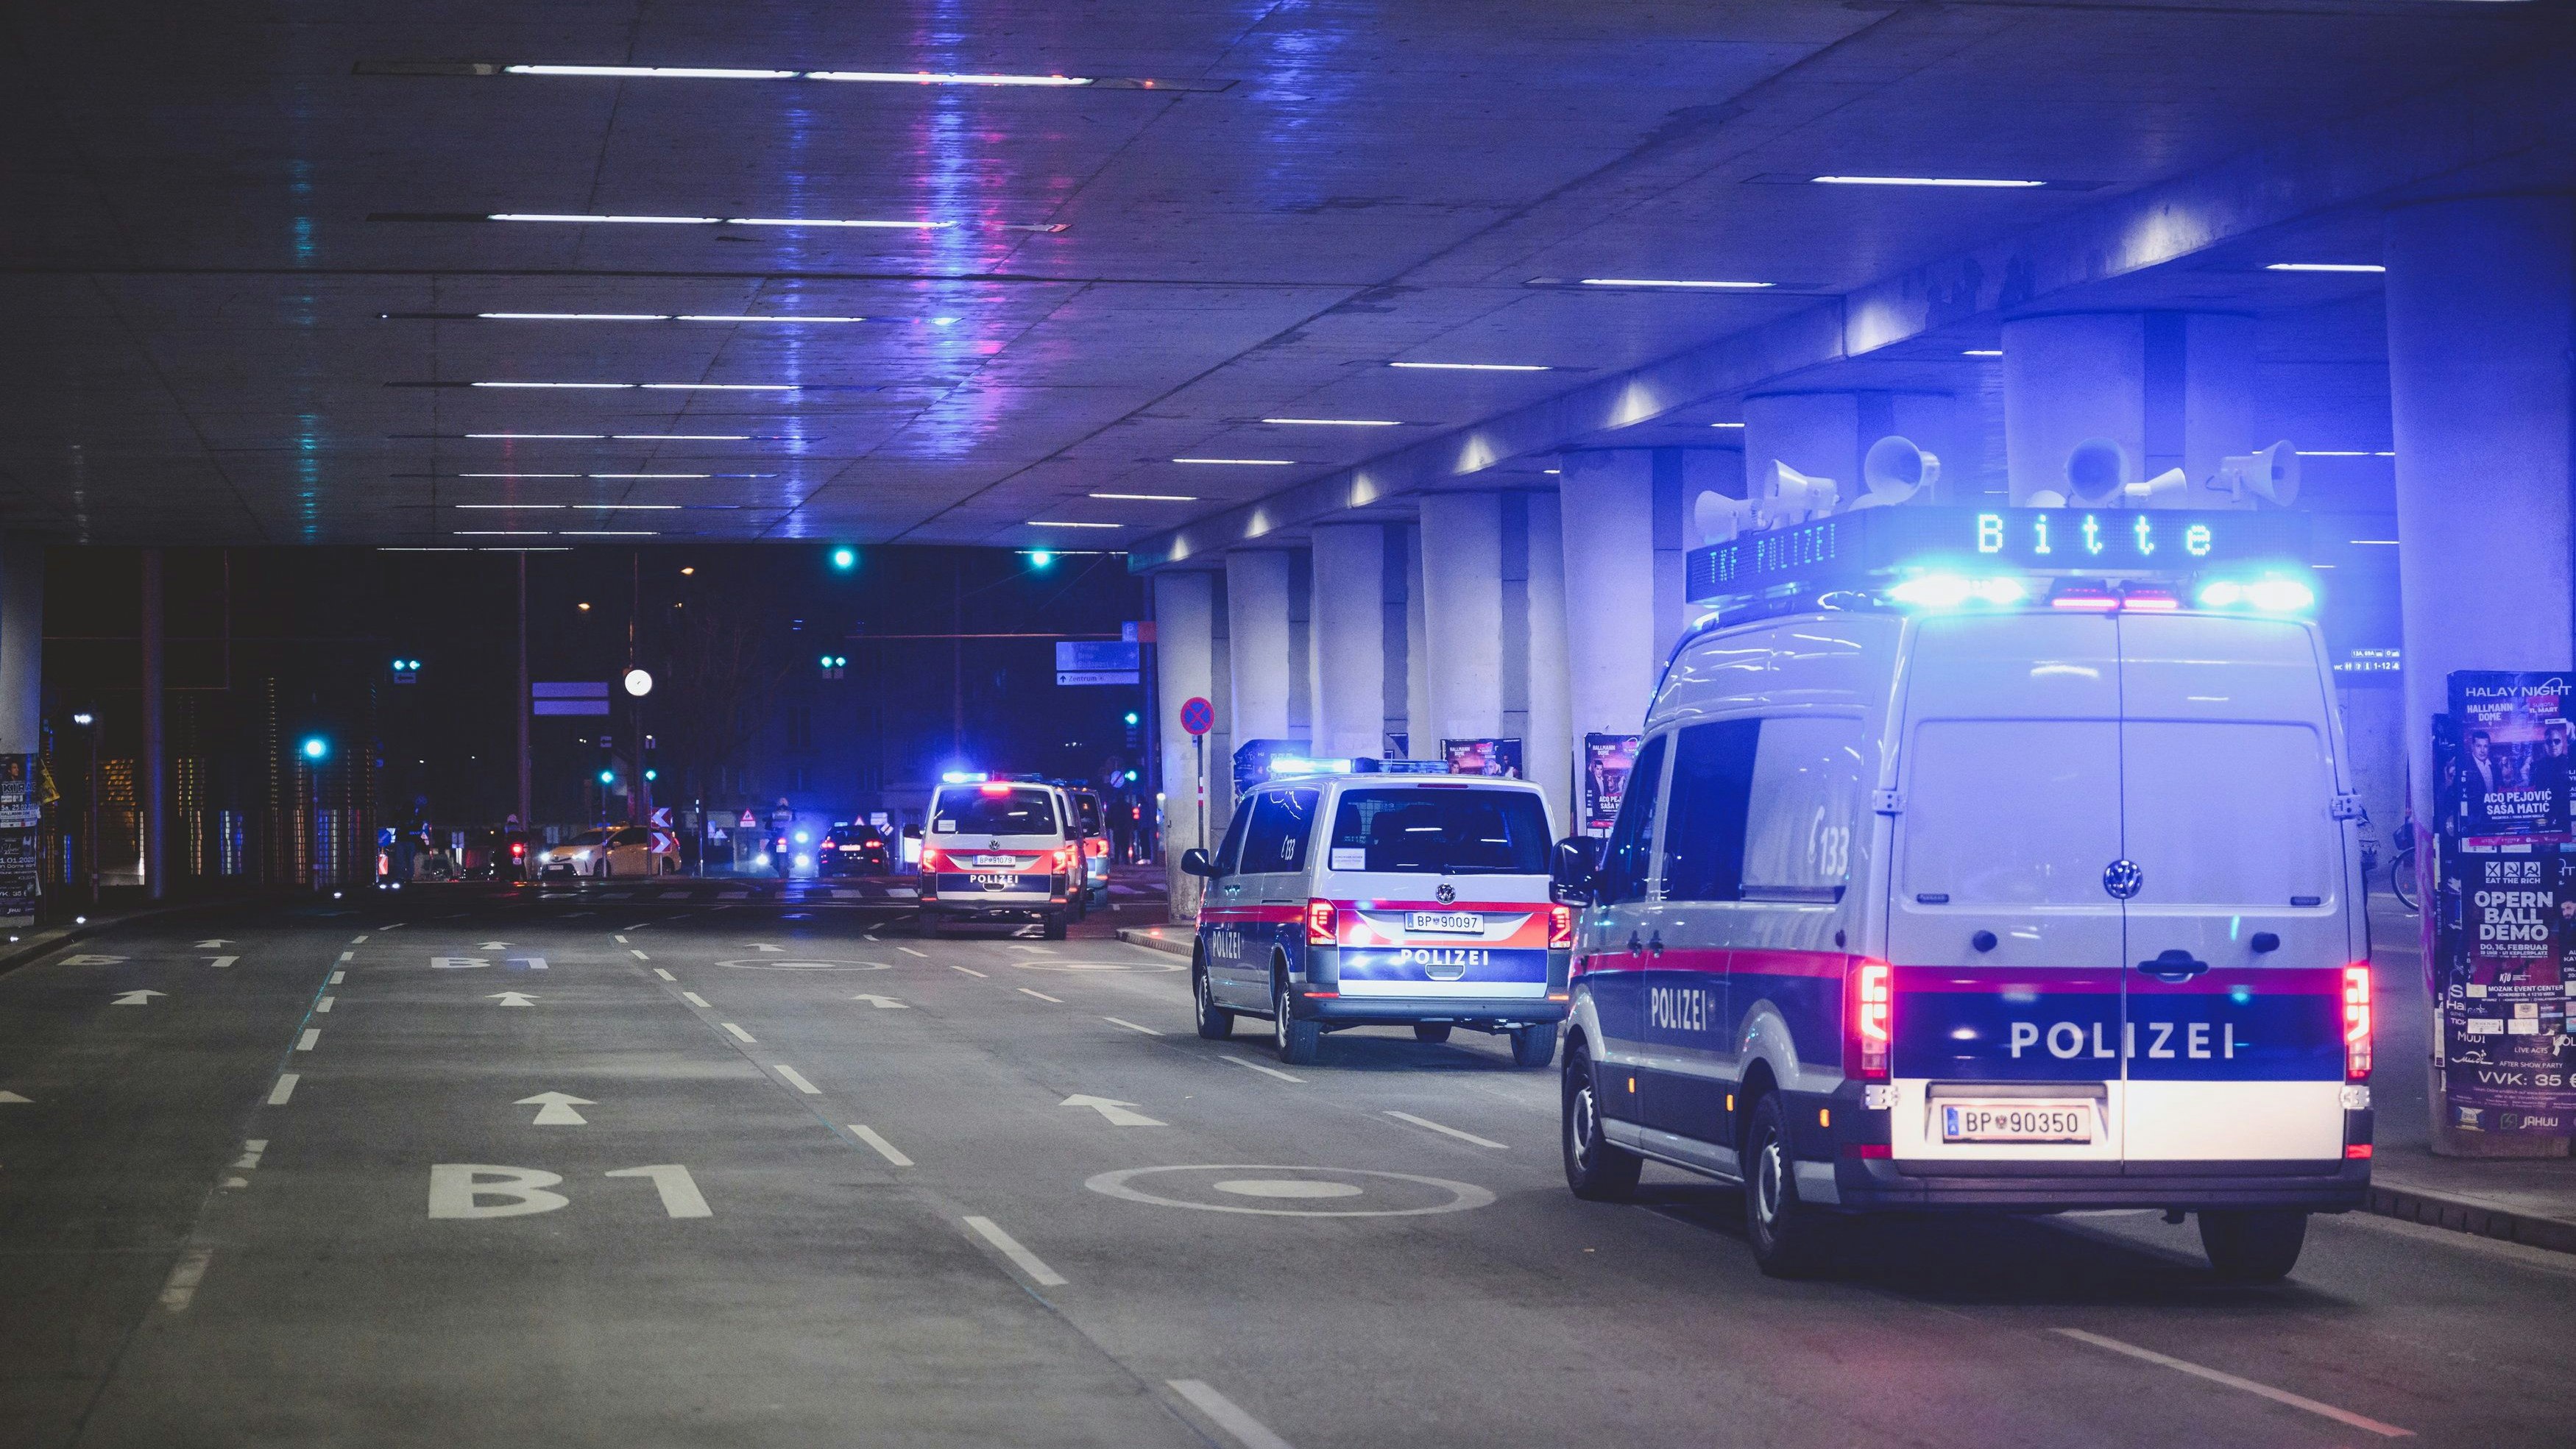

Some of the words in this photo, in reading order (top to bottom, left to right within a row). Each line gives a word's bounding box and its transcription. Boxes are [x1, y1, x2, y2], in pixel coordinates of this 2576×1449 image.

[1979, 514, 2210, 553] Bitte
[1759, 523, 1835, 573] POLIZEI
[2466, 687, 2518, 697] HALAY
[2522, 679, 2572, 697] NIGHT
[2466, 704, 2513, 713] HALLMANN
[2478, 712, 2502, 721] DOME
[2483, 793, 2505, 804] ACO
[2507, 788, 2552, 802] PEJOVIĆ
[2486, 802, 2515, 815] SAŠA
[2517, 800, 2550, 814] MATIĆ
[1285, 838, 1296, 860] 133
[1820, 826, 1850, 876] 133
[969, 874, 1019, 883] POLIZEI
[2474, 890, 2553, 908] OPERN
[1418, 915, 1432, 927] BP
[1441, 916, 1478, 928] 90097
[2485, 908, 2543, 924] BALL
[2480, 924, 2548, 940] DEMO
[1213, 931, 1240, 959] POLIZEI
[1400, 949, 1488, 966] POLIZEI
[1652, 988, 1706, 1030] POLIZEI
[2011, 1021, 2234, 1059] POLIZEI
[2478, 1071, 2527, 1085] VVK:
[2535, 1074, 2561, 1086] 35
[1967, 1113, 1991, 1132] BP
[2011, 1112, 2078, 1133] 90350
[428, 1163, 713, 1219] B1
